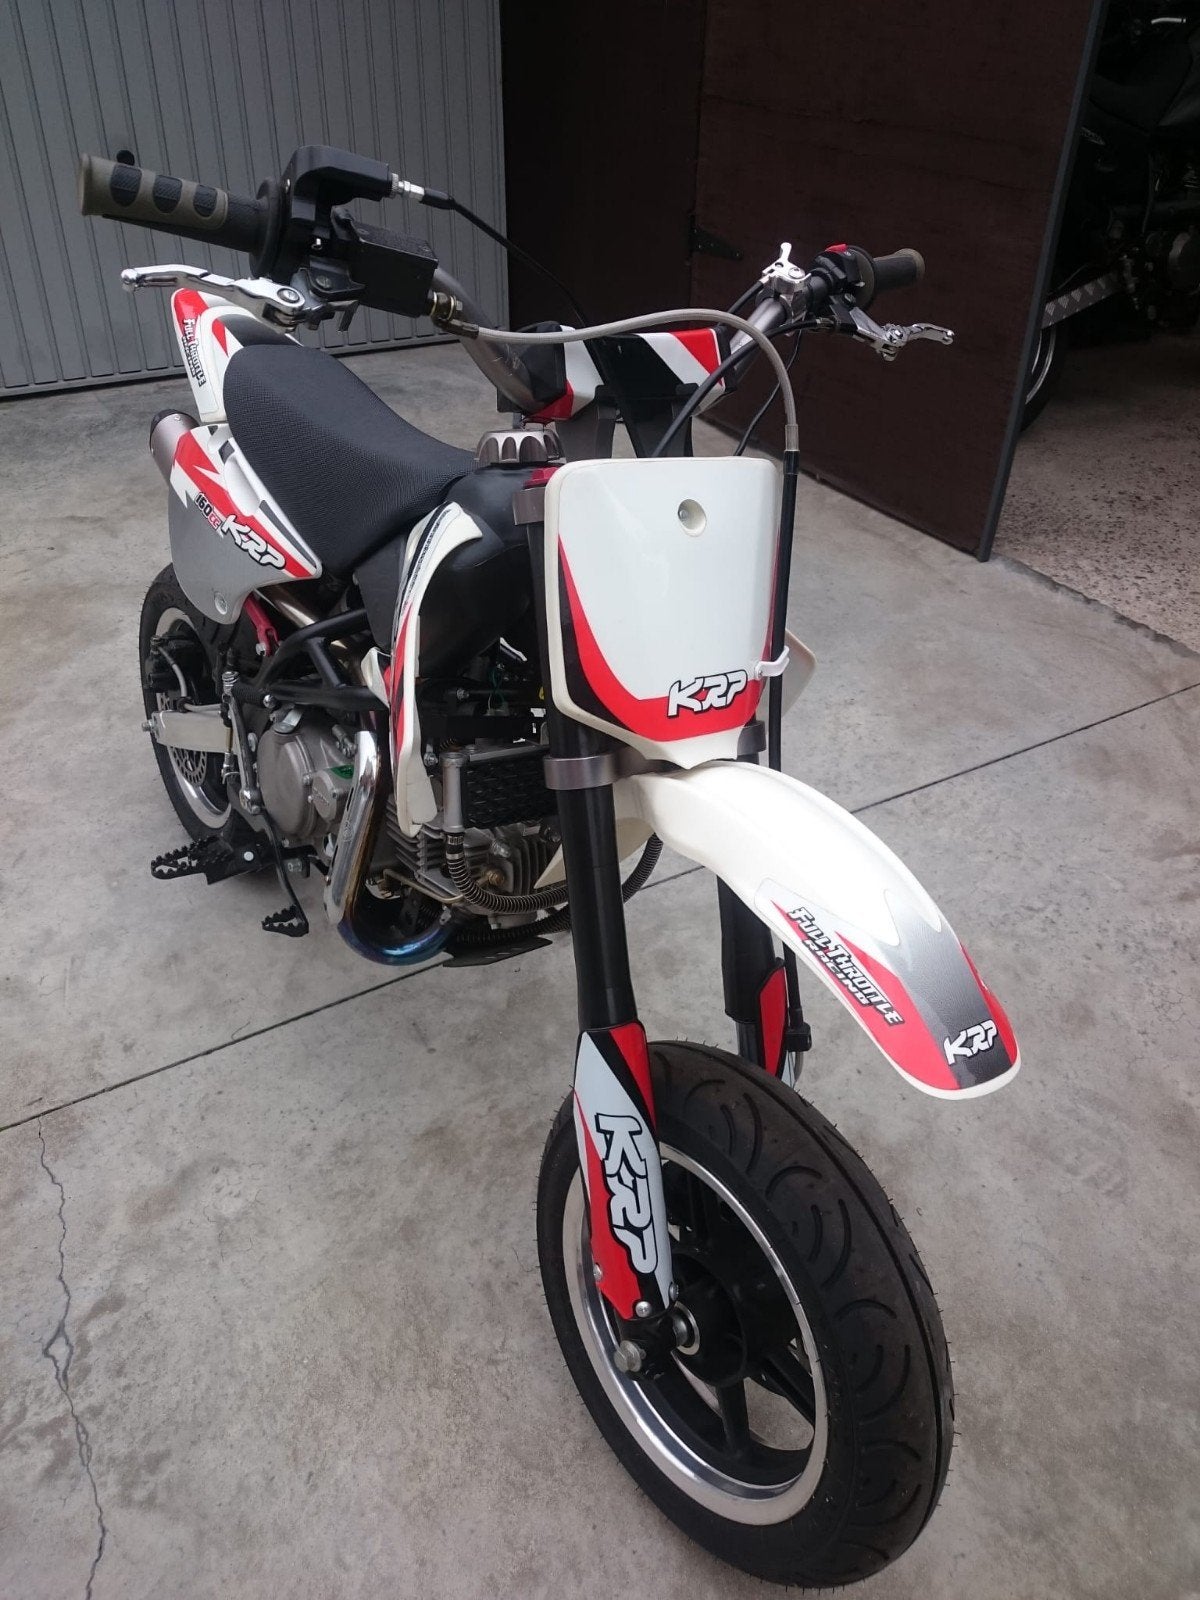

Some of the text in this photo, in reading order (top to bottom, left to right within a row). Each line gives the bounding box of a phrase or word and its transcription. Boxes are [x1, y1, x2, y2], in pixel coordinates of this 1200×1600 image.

[221, 514, 286, 570] KRP
[667, 669, 748, 718] KRP
[787, 906, 832, 949] FULL
[801, 939, 872, 1007] RACING
[943, 1018, 999, 1066] KRP
[594, 1112, 659, 1275] KRP
